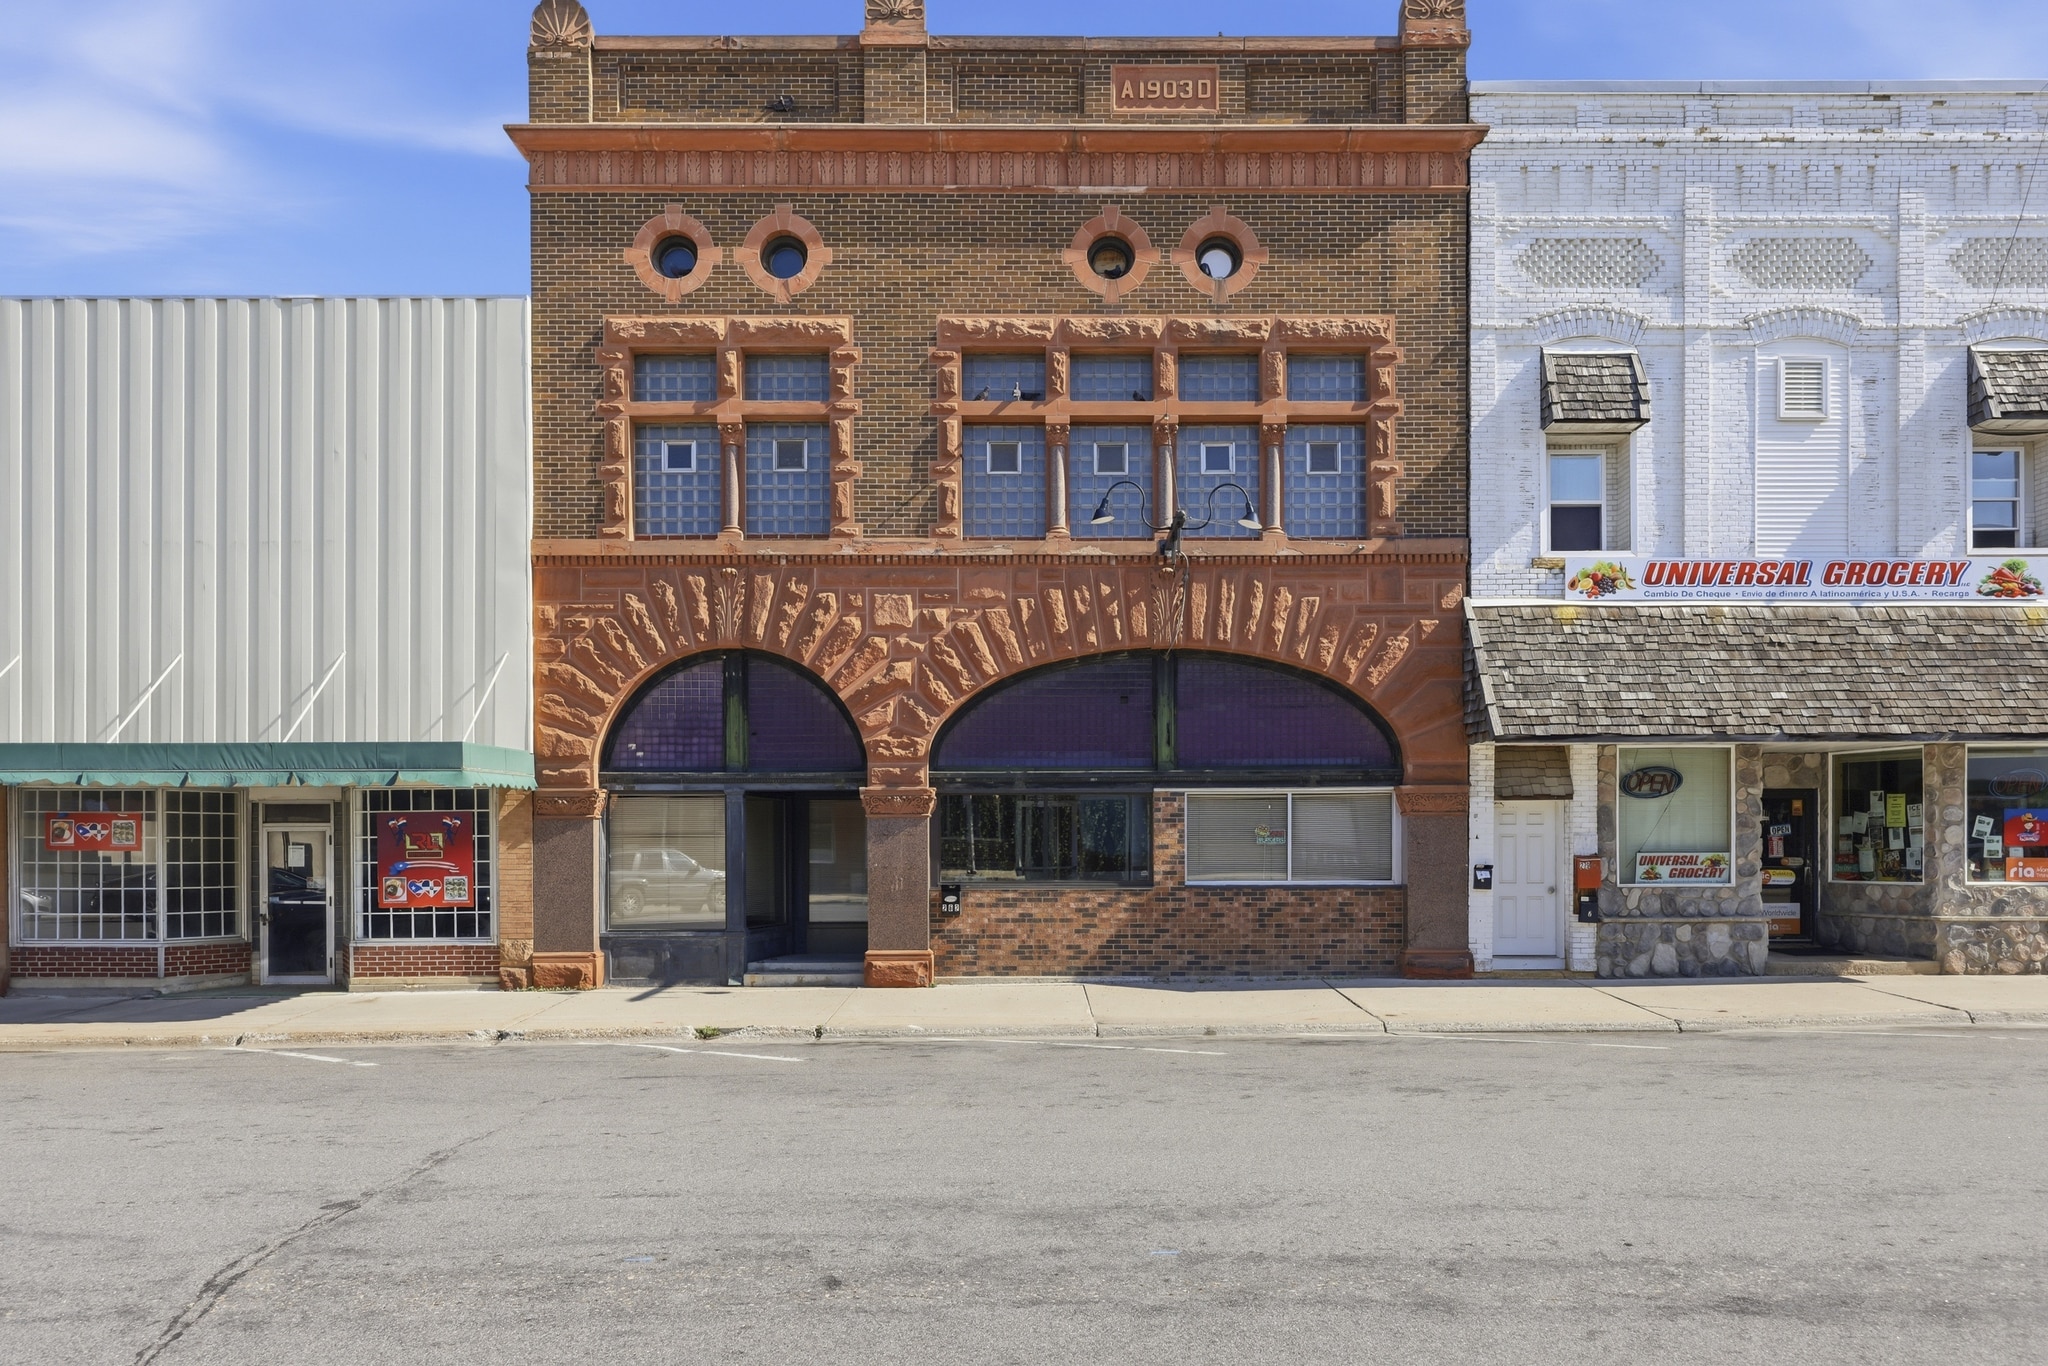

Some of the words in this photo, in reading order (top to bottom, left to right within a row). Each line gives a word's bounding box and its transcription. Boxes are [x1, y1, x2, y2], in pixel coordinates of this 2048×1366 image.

[1139, 79, 1193, 99] 1903
[1642, 560, 1811, 587] UNIVERSAL
[1822, 560, 1970, 587] GROCERY
[1643, 590, 1679, 598] Cambio
[1681, 590, 1693, 598] De
[1696, 590, 1731, 599] Cheque
[1765, 590, 1776, 598] de
[1779, 590, 1809, 598] dinero
[1810, 590, 1818, 598] A
[1819, 589, 1882, 598] latinoamérica
[1884, 591, 1890, 599] y
[1892, 590, 1920, 598] U.S.A.
[1628, 772, 1674, 793] OPEN
[1995, 775, 2040, 793] OPEN
[1908, 804, 1921, 812] ICE
[1771, 825, 1790, 835] OPEN
[1639, 855, 1699, 866] UNIVERSAL
[1668, 867, 1726, 878] GROCERY
[2009, 861, 2035, 878] ria
